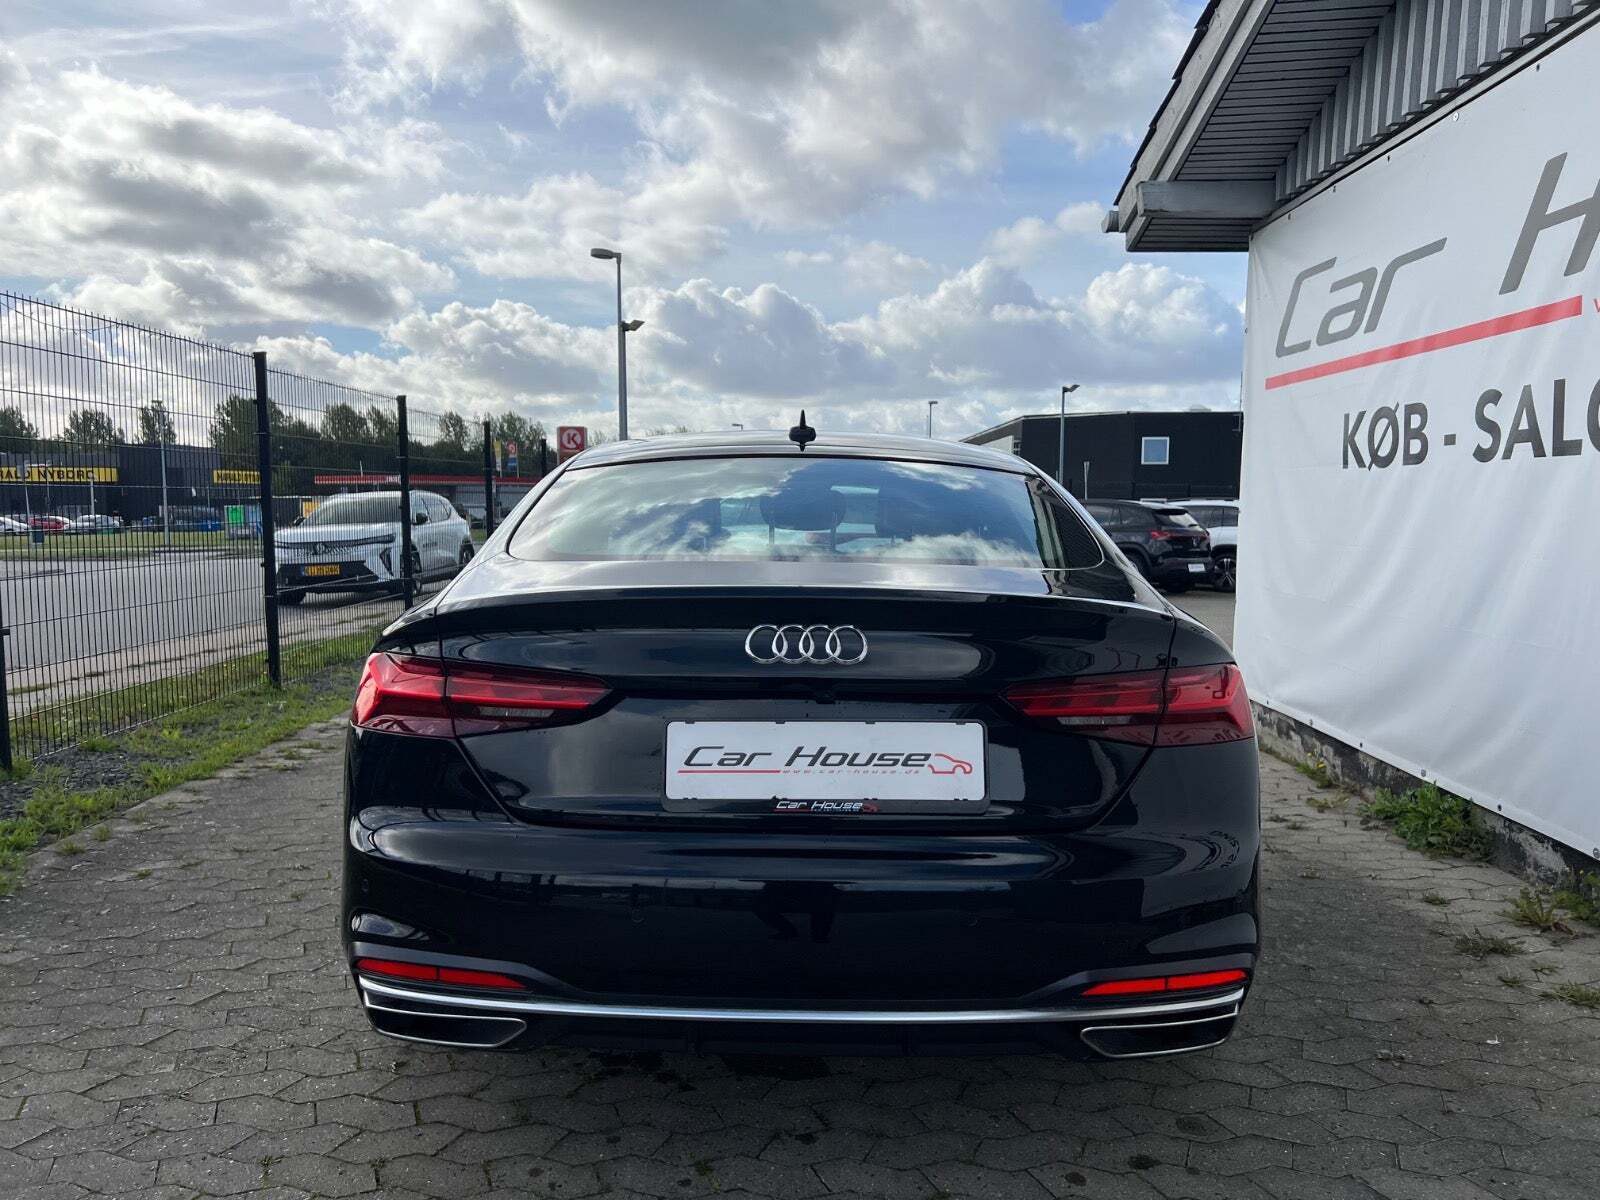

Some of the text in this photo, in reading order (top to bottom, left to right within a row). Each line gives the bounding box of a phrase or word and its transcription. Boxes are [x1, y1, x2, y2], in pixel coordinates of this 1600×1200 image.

[1275, 236, 1448, 359] Car
[567, 432, 580, 449] K
[1342, 402, 1429, 471] KØB
[683, 745, 933, 768] Car House
[776, 800, 808, 809] Car
[811, 800, 863, 810] House
